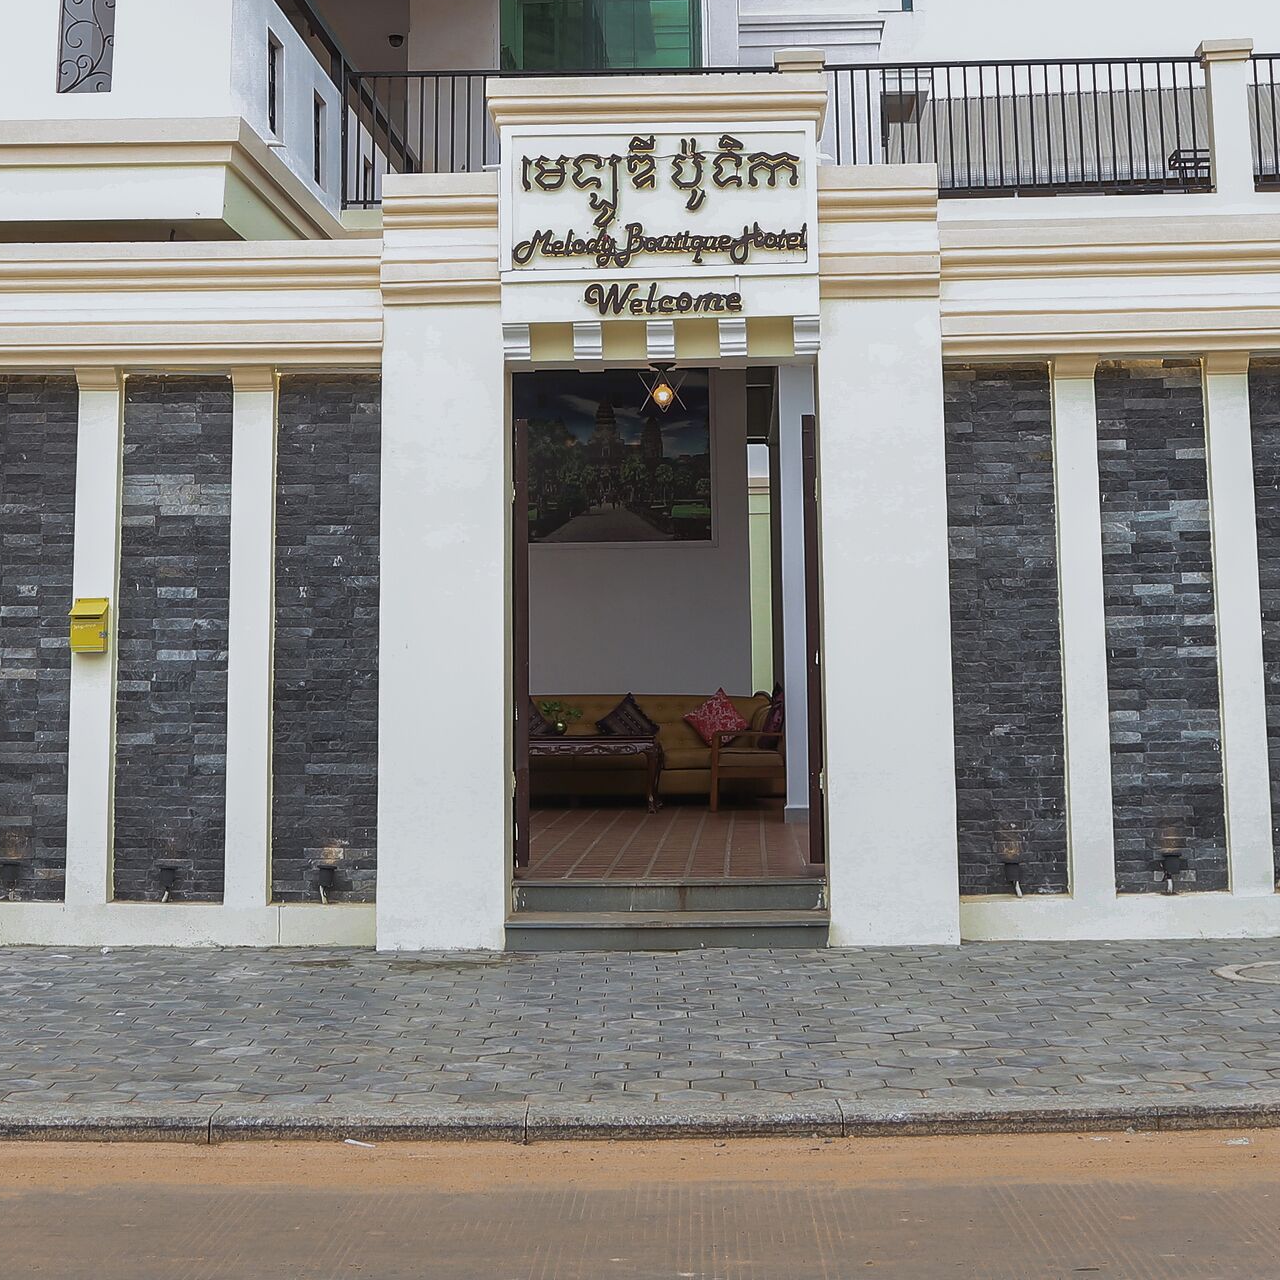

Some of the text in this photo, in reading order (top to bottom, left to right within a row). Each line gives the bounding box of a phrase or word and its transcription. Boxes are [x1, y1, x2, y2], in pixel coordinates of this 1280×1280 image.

[512, 221, 808, 268] Melody Boutique Hotel
[584, 282, 744, 315] Welcome
